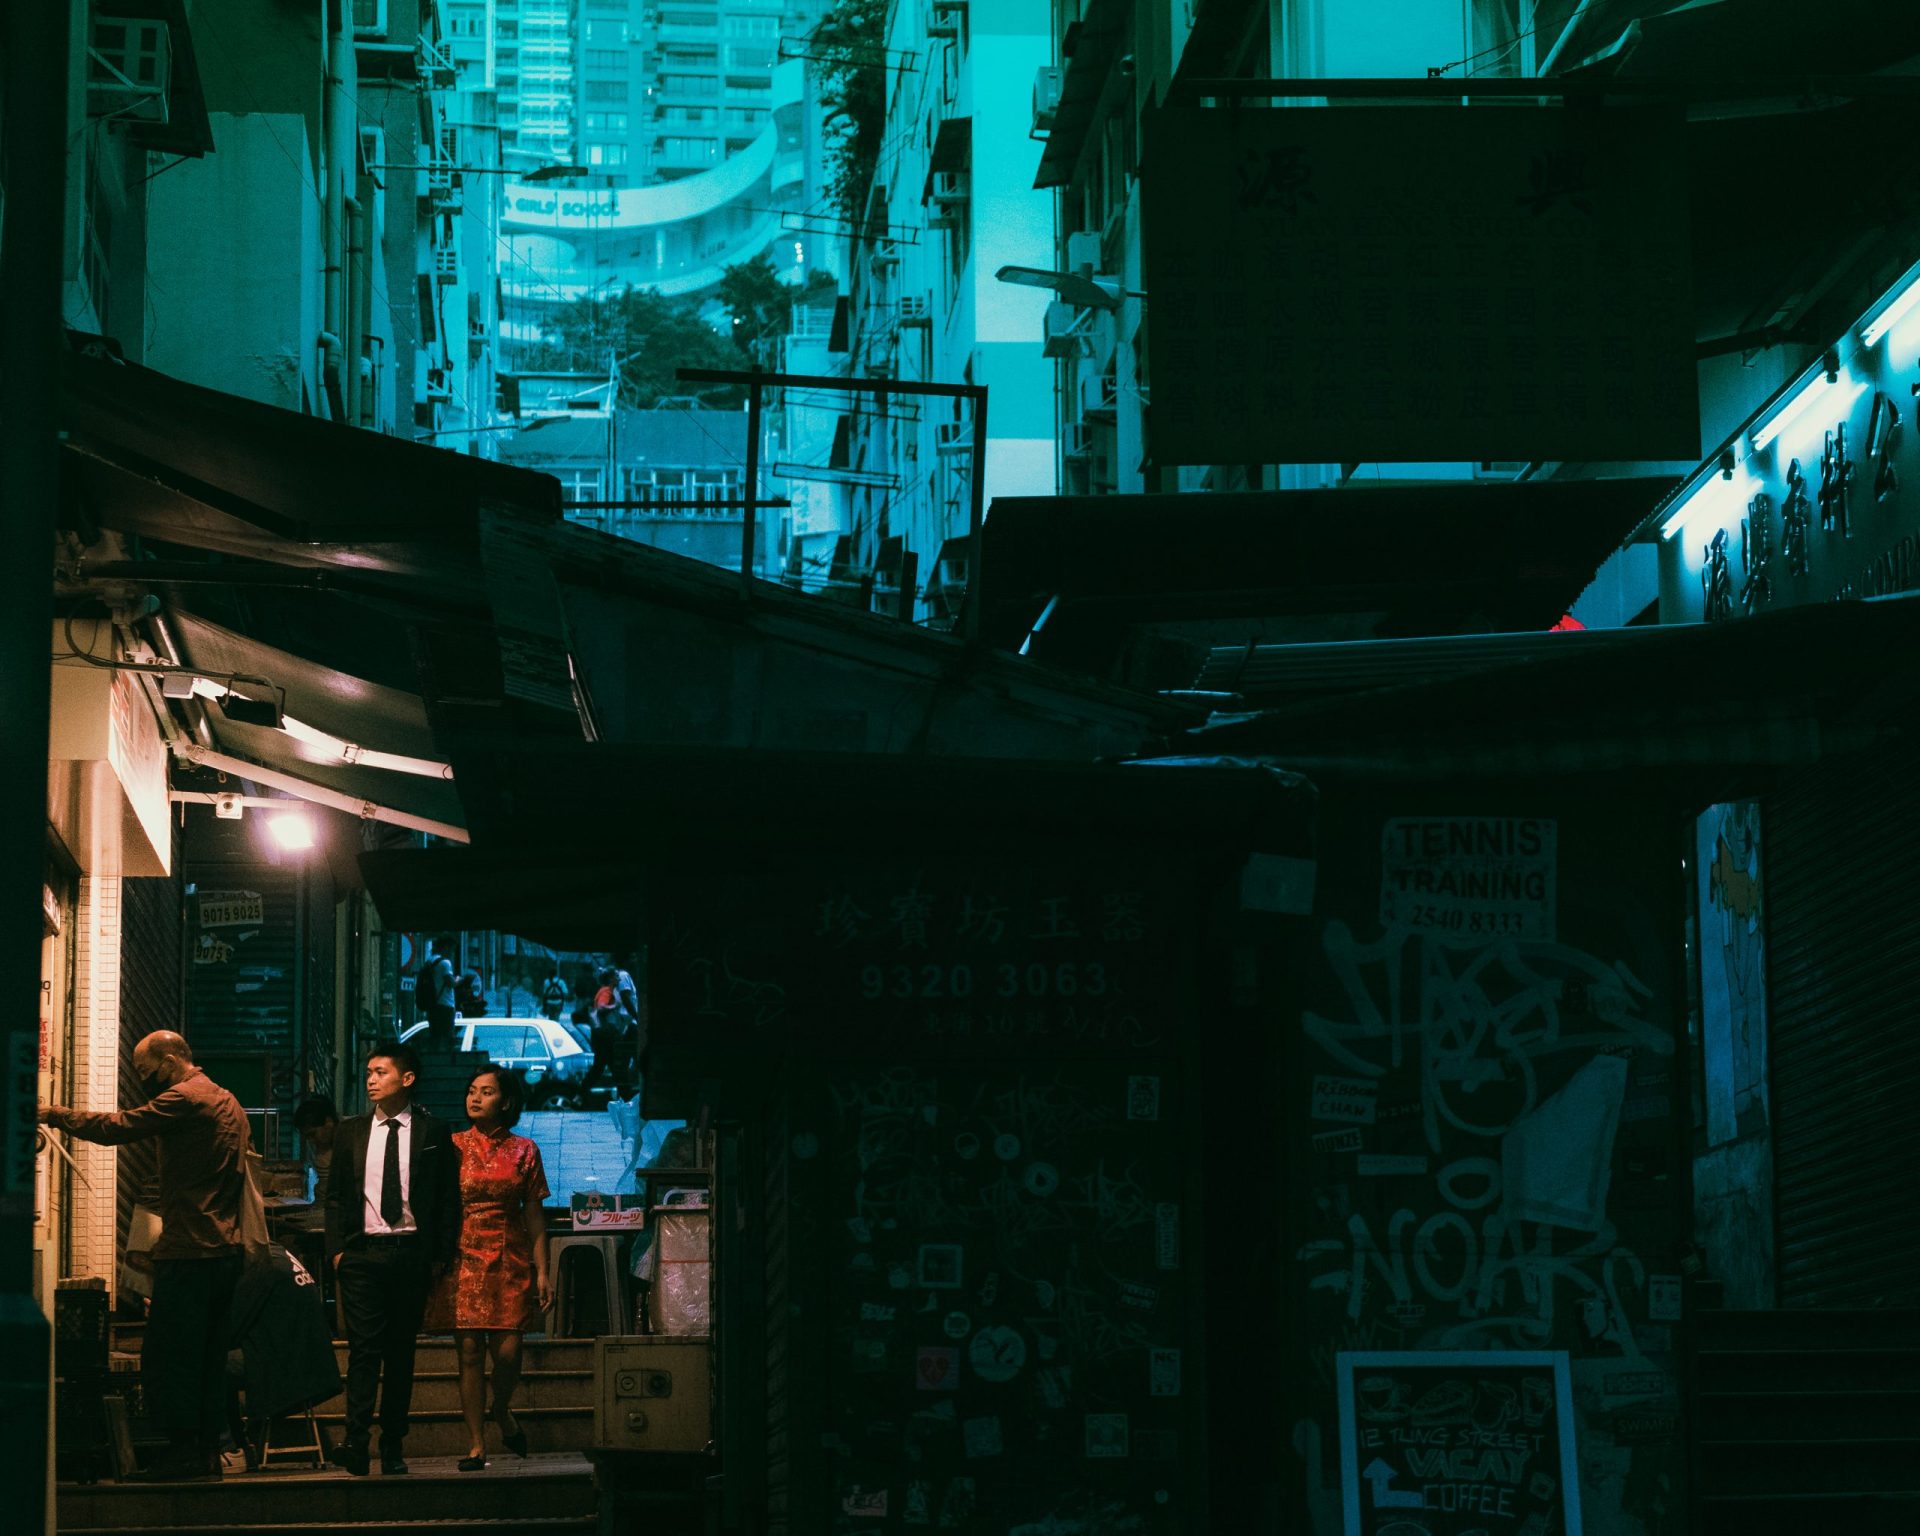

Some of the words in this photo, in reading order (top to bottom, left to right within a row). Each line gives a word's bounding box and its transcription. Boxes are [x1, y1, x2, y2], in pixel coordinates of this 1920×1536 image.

[1395, 820, 1542, 858] TENNIS
[1394, 868, 1546, 901] TRAINING
[203, 907, 231, 923] 9075
[233, 904, 261, 920] 9025
[1411, 904, 1464, 931] 2540
[1468, 907, 1524, 934] 8333
[859, 962, 974, 1000] 9320
[997, 961, 1107, 999] 3063
[601, 1211, 642, 1224] フルーツ
[1359, 1429, 1385, 1449] 12
[1455, 1428, 1546, 1453] STREET
[1404, 1447, 1534, 1485] VACAY
[1422, 1483, 1516, 1518] COFFEE
